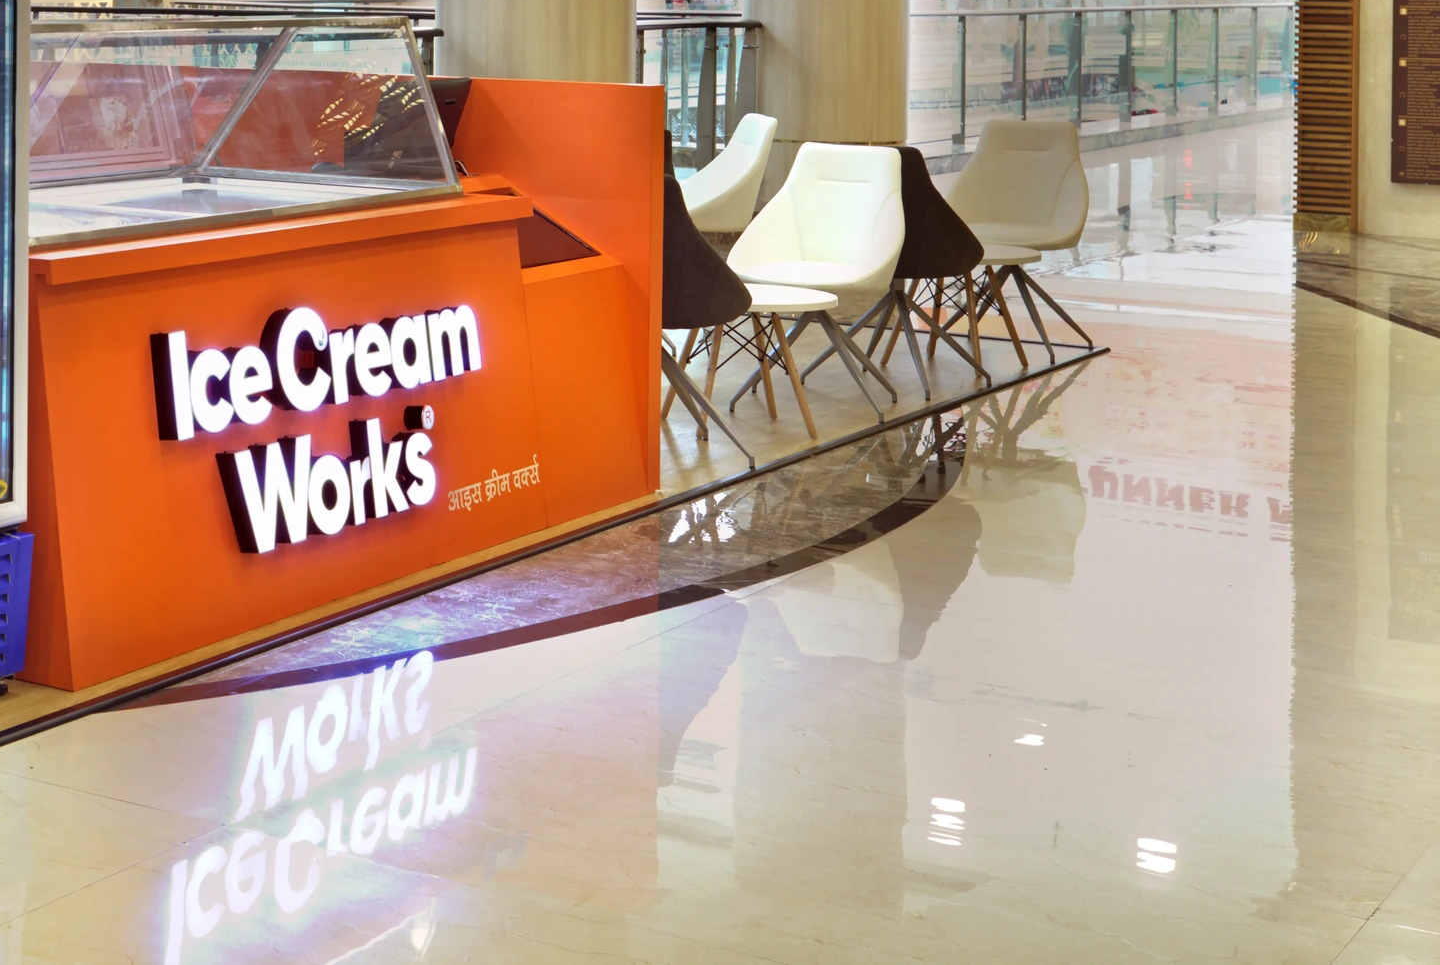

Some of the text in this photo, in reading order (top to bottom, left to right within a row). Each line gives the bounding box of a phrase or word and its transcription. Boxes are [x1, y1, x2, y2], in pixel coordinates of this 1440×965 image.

[447, 453, 541, 512] आइस क्रीम वर्क्स
